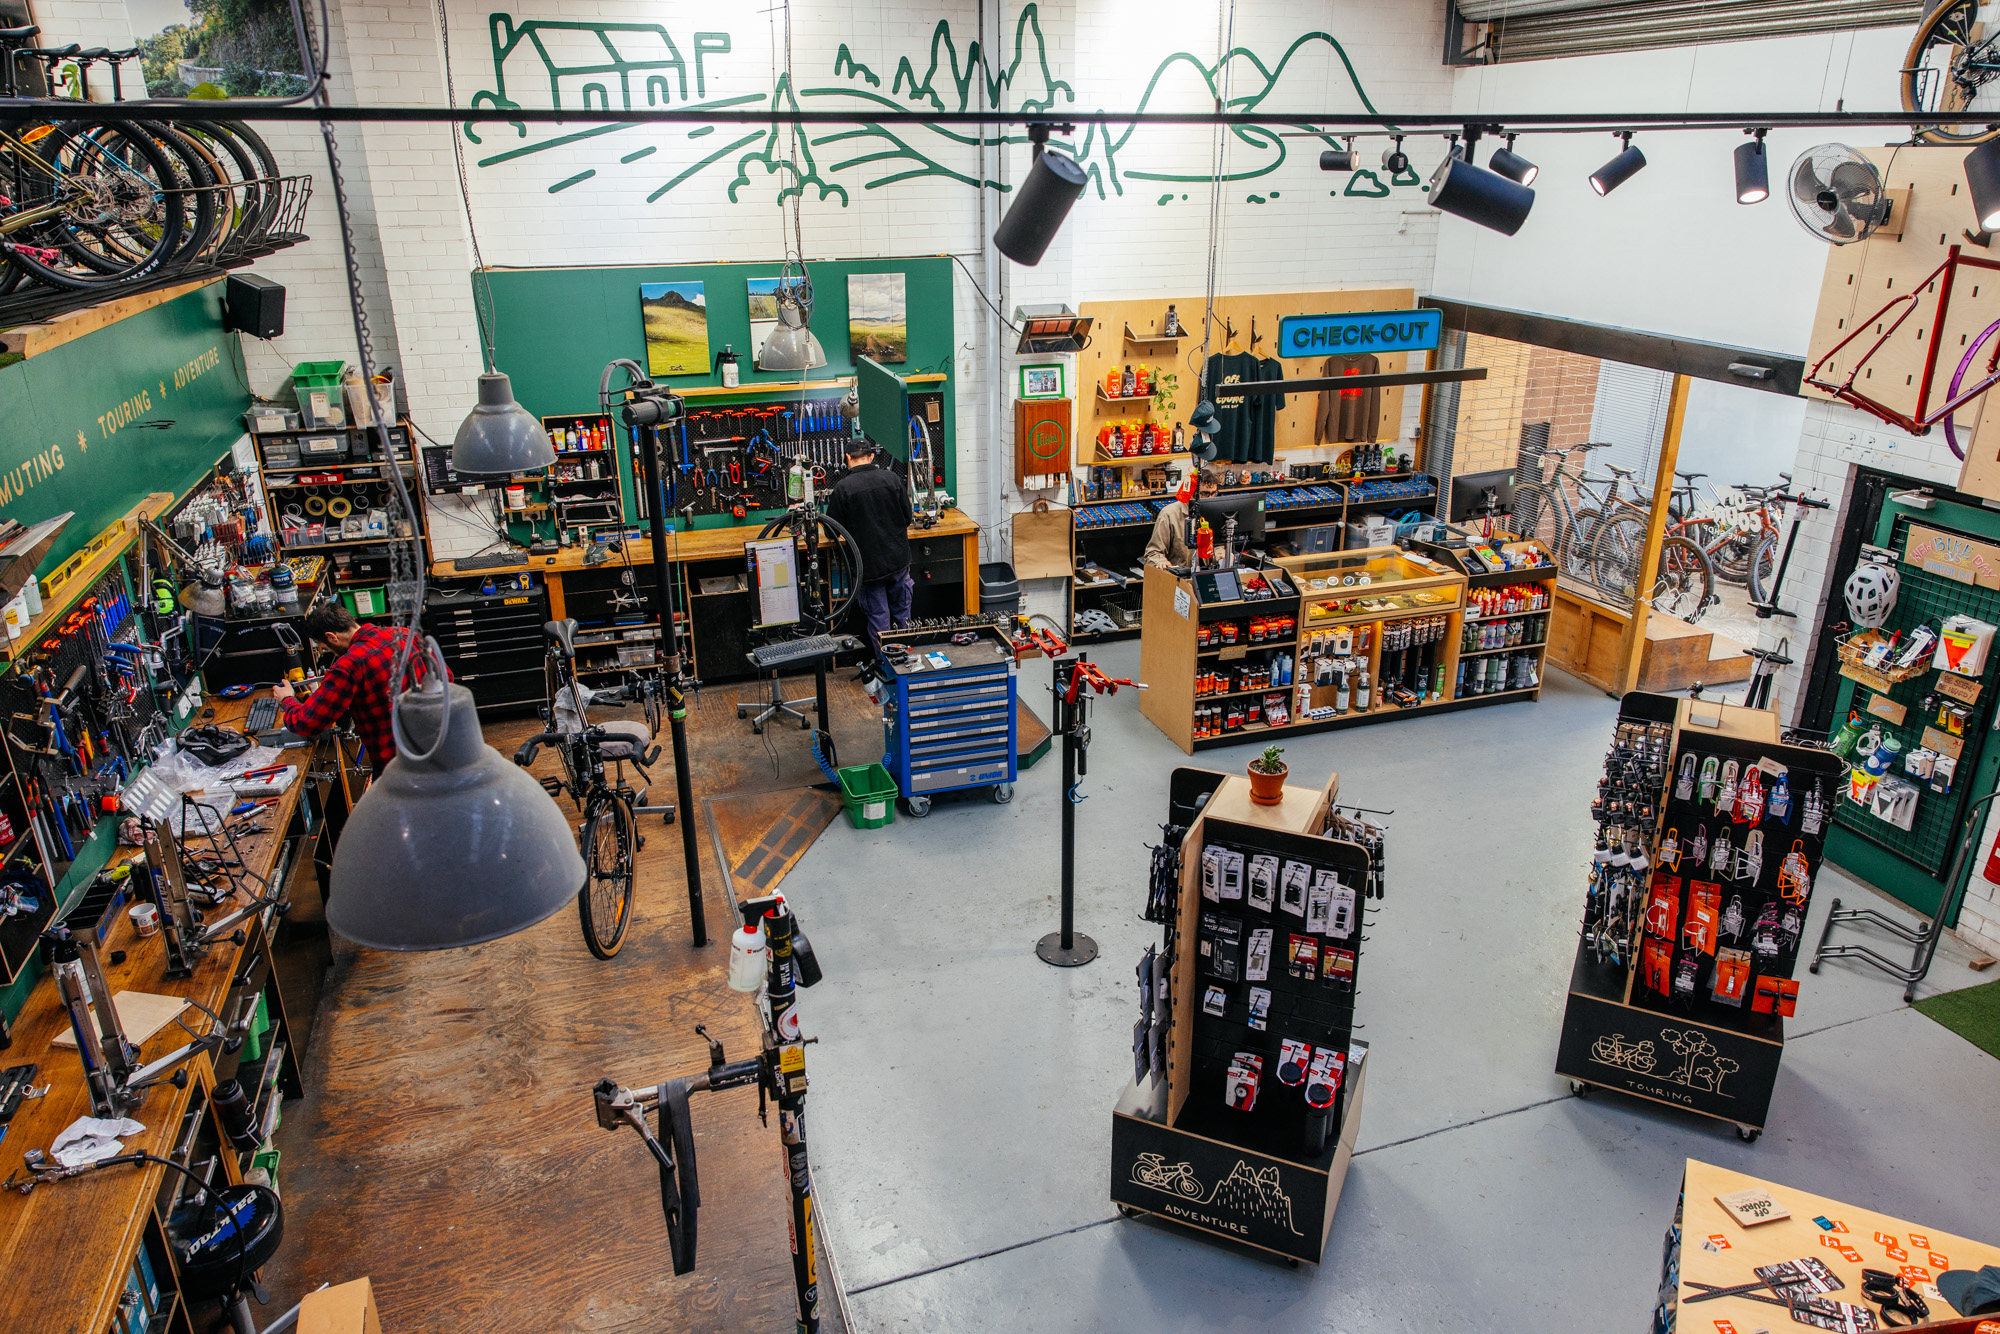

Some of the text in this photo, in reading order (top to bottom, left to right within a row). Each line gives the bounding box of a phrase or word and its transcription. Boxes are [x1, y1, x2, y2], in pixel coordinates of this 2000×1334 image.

[1293, 321, 1430, 347] CHECK-OUT
[98, 390, 152, 439] TOURING
[174, 346, 220, 391] ADVENTURE
[1036, 432, 1058, 447] Tubes
[1910, 536, 1998, 578] NEW BIKE DAY
[1924, 560, 1974, 582] STARTER KIT
[1626, 1080, 1693, 1104] TOURING
[1164, 1203, 1250, 1235] ADVENTURE
[1754, 1208, 1770, 1217] OFF
